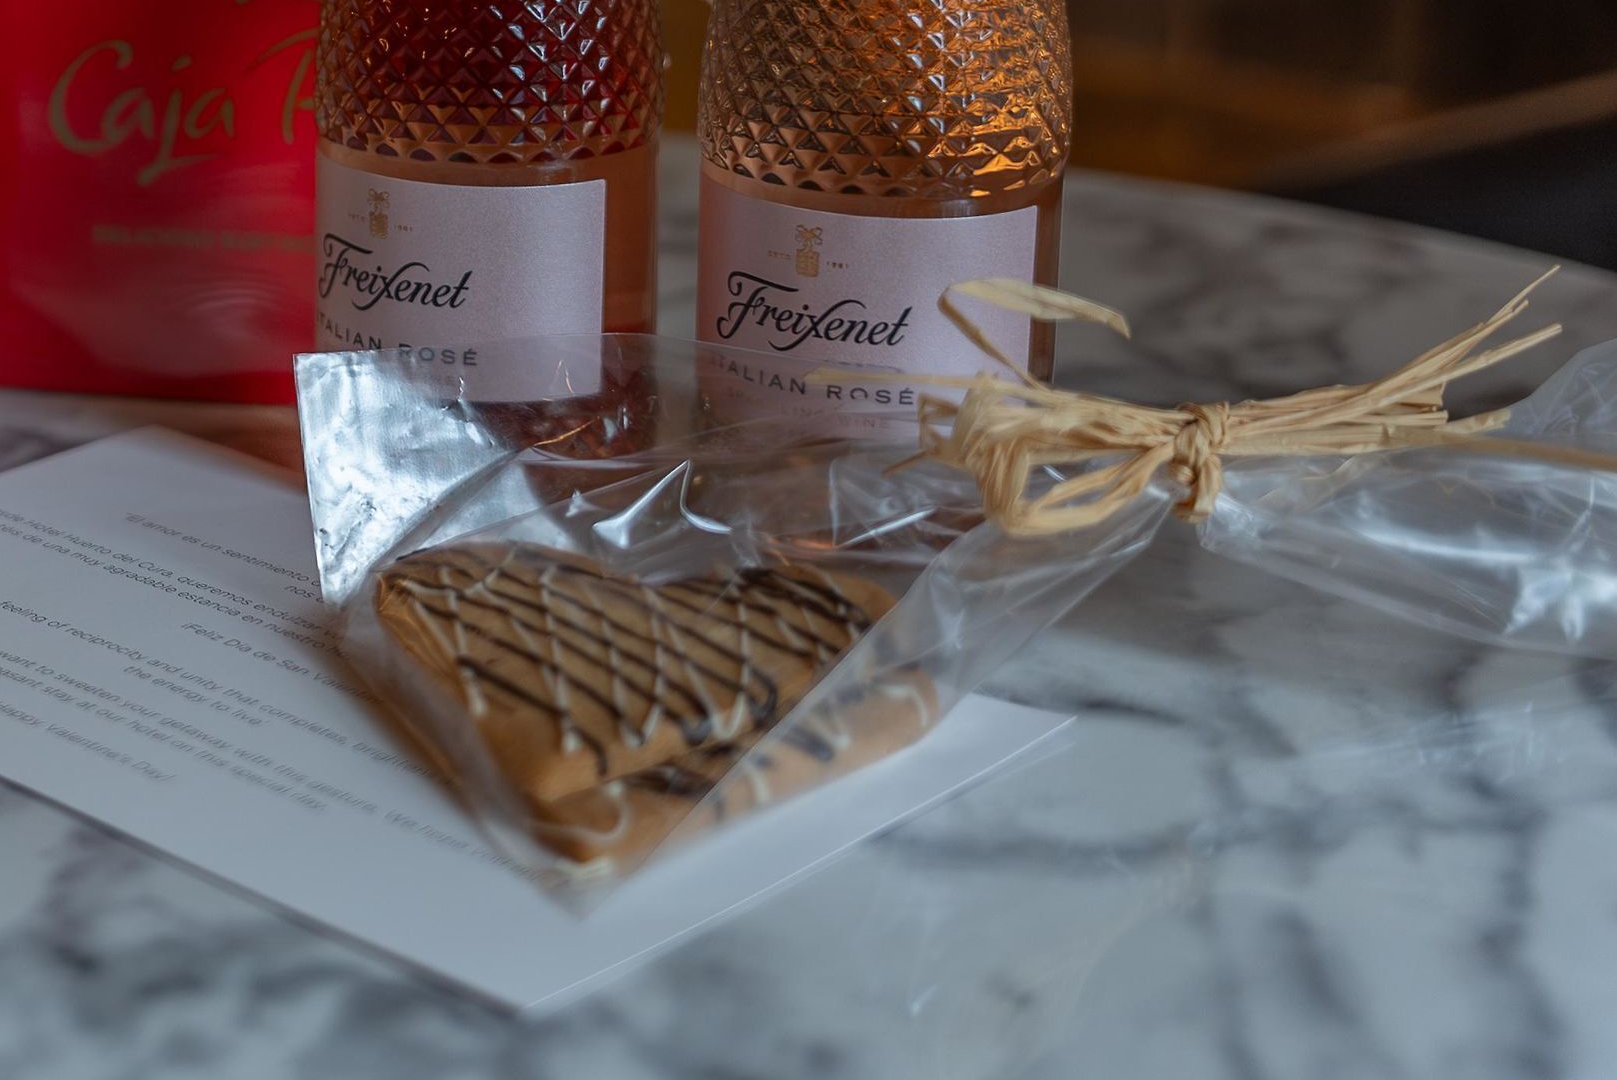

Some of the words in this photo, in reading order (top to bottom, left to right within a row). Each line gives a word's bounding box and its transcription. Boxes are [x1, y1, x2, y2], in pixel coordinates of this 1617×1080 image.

[48, 39, 235, 186] Caja
[319, 233, 473, 311] Freixenet
[317, 310, 382, 350] TALIAN
[716, 270, 913, 352] Freixenet
[826, 386, 915, 405] ROSÉ
[143, 522, 183, 536] amor
[221, 549, 310, 580] sentimiento
[282, 585, 314, 597] nos
